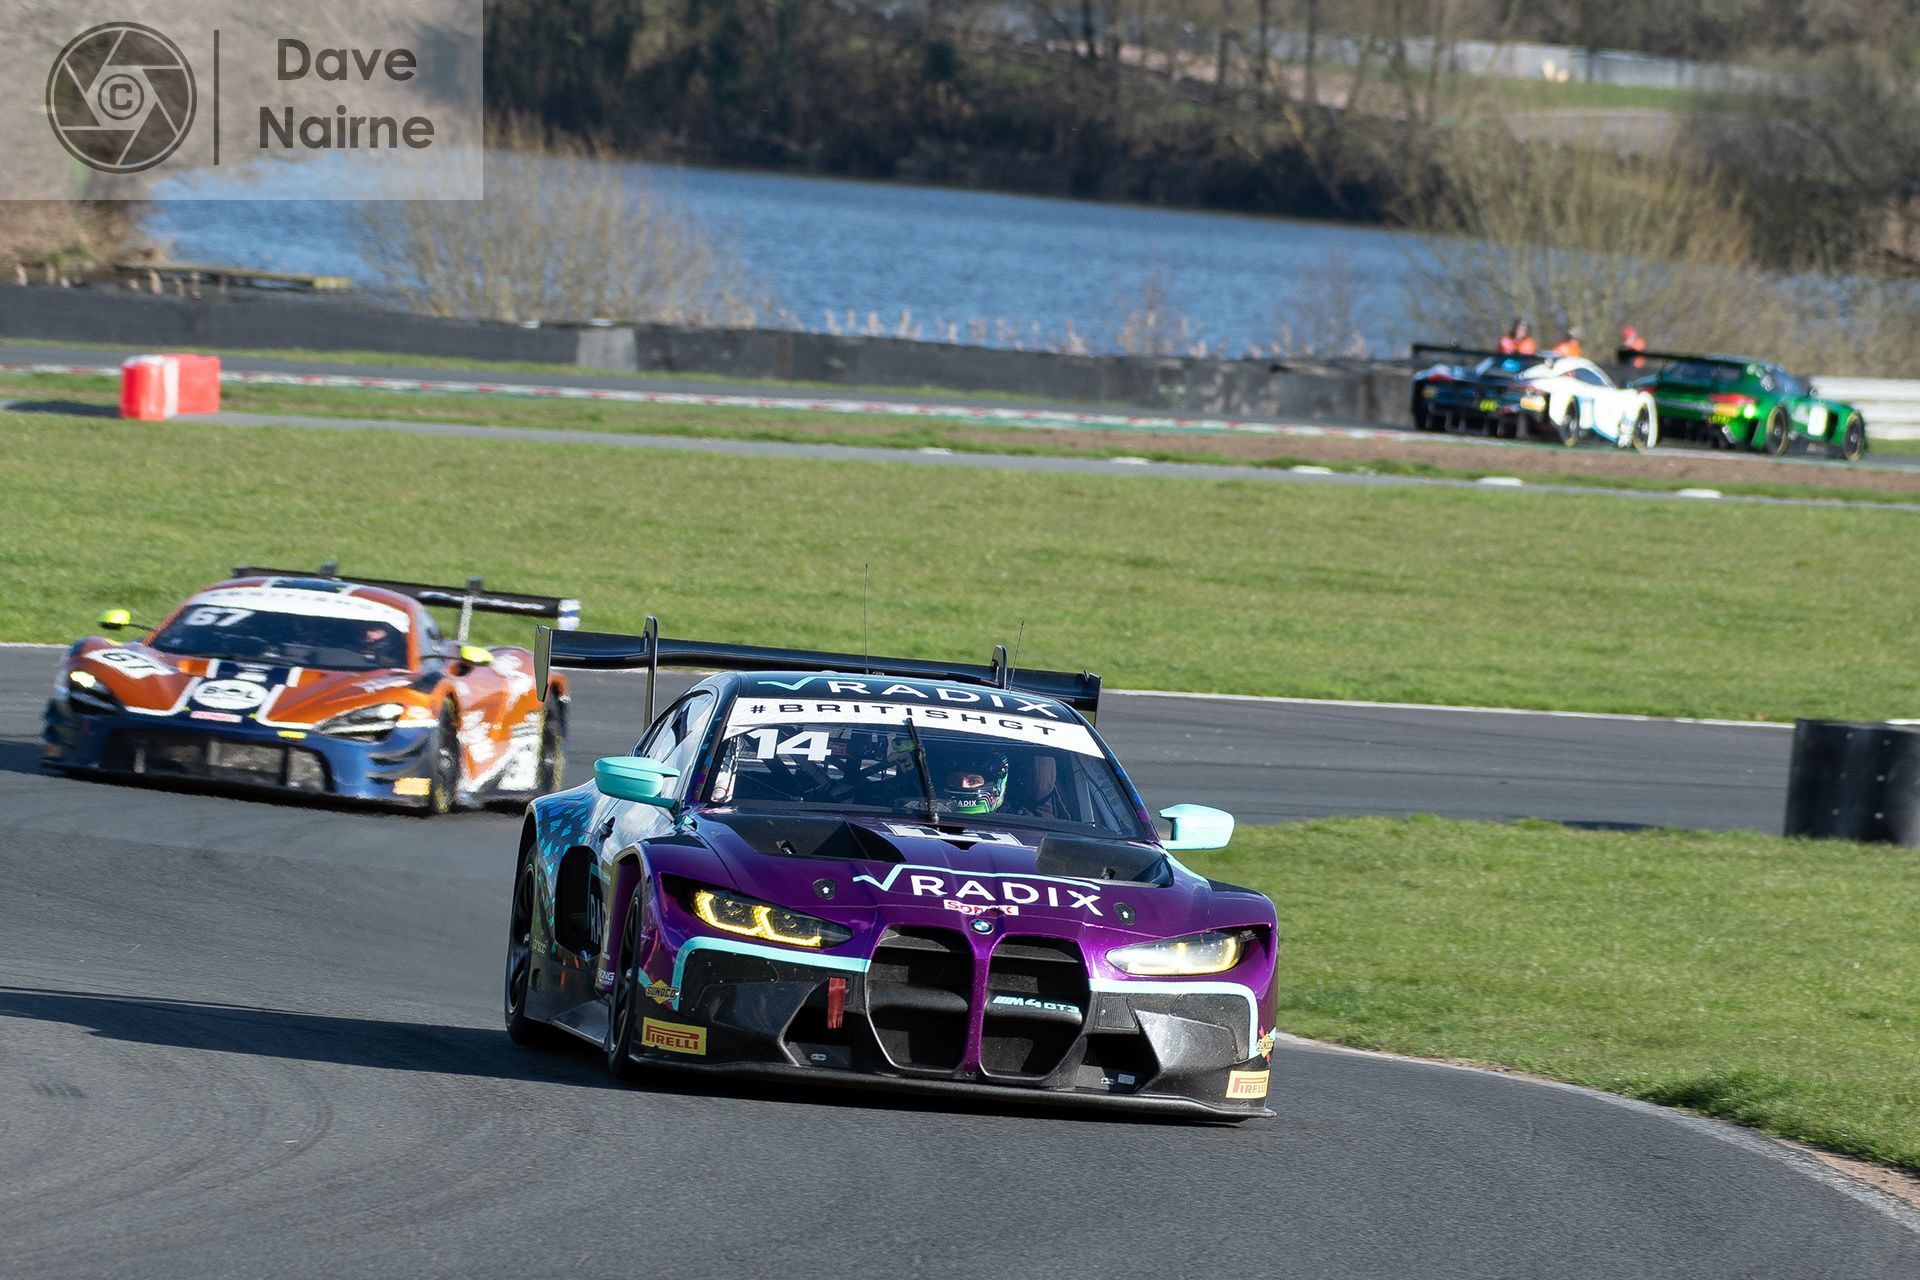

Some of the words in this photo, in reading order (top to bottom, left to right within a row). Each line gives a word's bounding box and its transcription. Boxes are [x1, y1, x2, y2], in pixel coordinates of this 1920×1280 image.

[184, 606, 255, 627] 67
[827, 680, 1059, 719] RADIX
[750, 702, 1057, 736] #BRITISHGT
[746, 728, 832, 762] 14
[956, 799, 977, 807] ADIX
[910, 874, 1104, 917] RADIX
[646, 986, 678, 998] SUNOCO
[1044, 1002, 1080, 1014] GT3
[646, 1024, 700, 1050] PIRELLI
